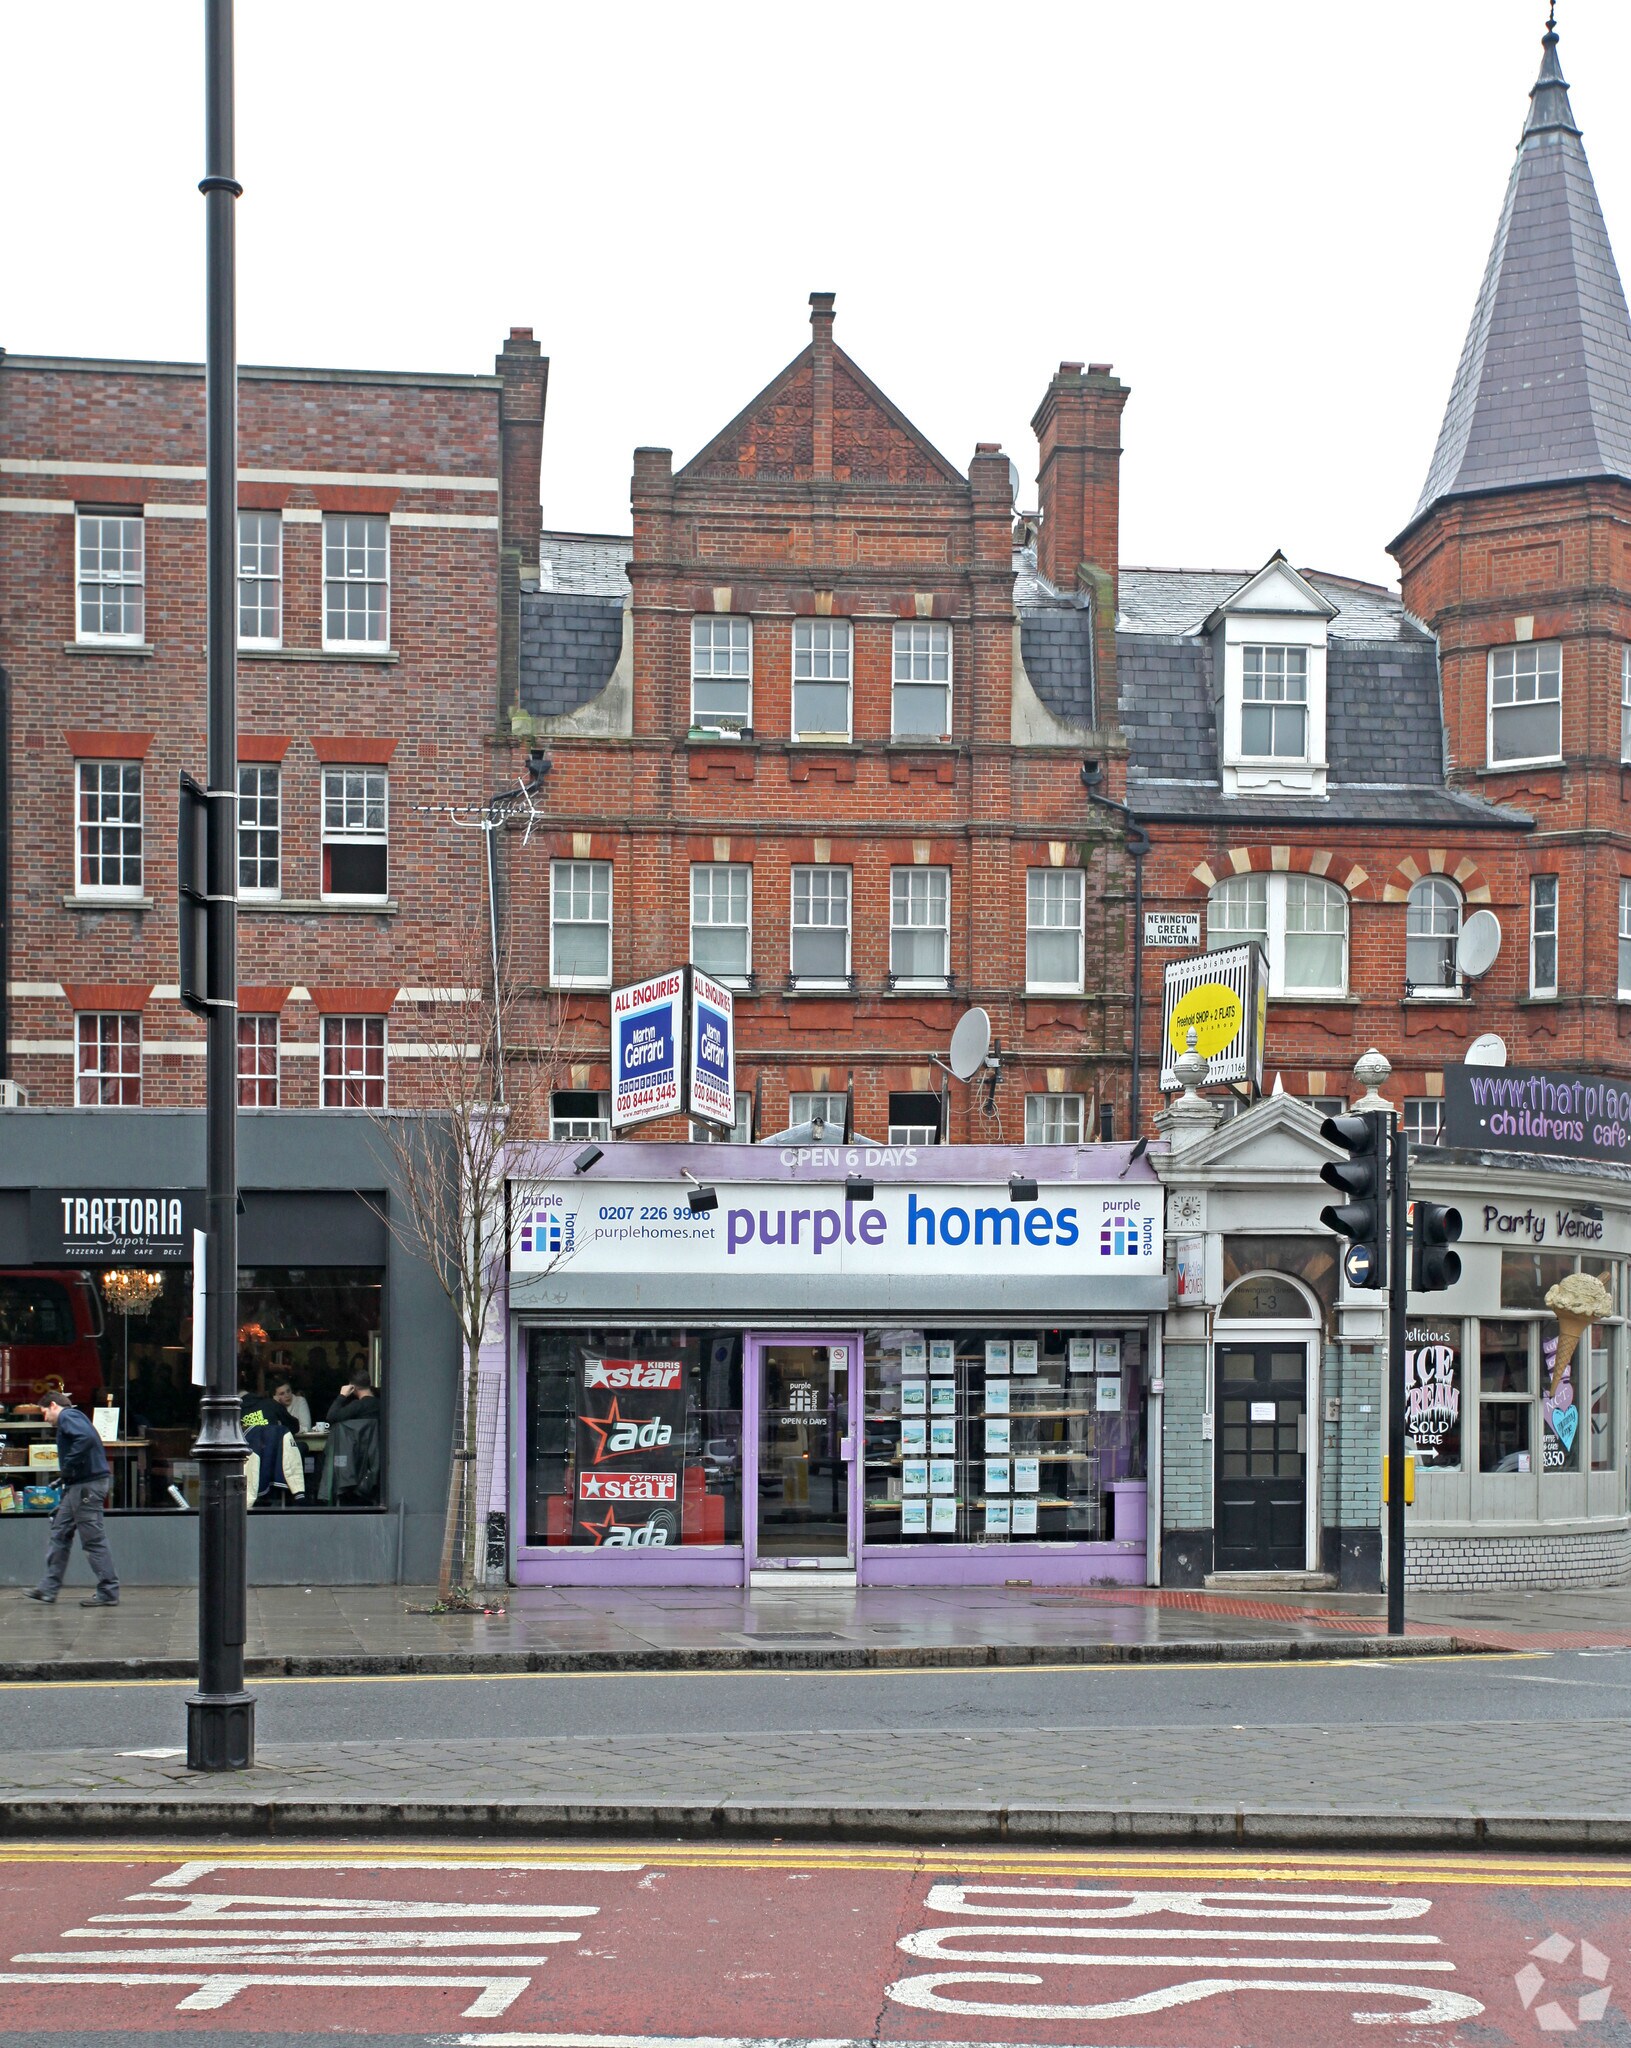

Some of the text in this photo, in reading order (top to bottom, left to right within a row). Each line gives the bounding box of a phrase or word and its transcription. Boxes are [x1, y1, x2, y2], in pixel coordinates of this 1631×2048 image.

[1147, 914, 1198, 924] NEWINGTON
[1157, 925, 1188, 934] GREEN
[615, 975, 680, 1013] ALL ENQUIRIES
[694, 976, 731, 1013] ALL ENQUIRIES
[1176, 1012, 1195, 1028] Freehold
[1195, 1010, 1209, 1024] SHOP
[1214, 1009, 1219, 1020] 2
[1218, 1005, 1236, 1019] FLATS
[632, 1026, 656, 1044] Martyn
[625, 1037, 664, 1069] Gerrard
[701, 1033, 725, 1068] Gerrard
[1210, 1066, 1226, 1076] 1177
[1231, 1063, 1246, 1074] 1166
[617, 1083, 677, 1111] 020 8444 3445
[1470, 1075, 1631, 1122] www.thatplac
[1490, 1110, 1626, 1148] children's cafe
[780, 1149, 917, 1167] OPEN 6 DAYS
[523, 1194, 563, 1208] purple
[1102, 1199, 1141, 1213] purple
[61, 1198, 182, 1235] TRATTORIA
[599, 1207, 711, 1221] 0207 226 9966
[727, 1193, 1079, 1255] purple homes
[1484, 1205, 1545, 1242] Party
[97, 1216, 150, 1248] Sapori
[565, 1213, 577, 1252] homes
[595, 1226, 716, 1241] purplehomes.net
[1142, 1217, 1155, 1256] homes
[163, 1248, 182, 1256] DELI
[1252, 1295, 1278, 1310] 1-3
[609, 1363, 680, 1388] star
[647, 1361, 681, 1369] KIBRIS
[1405, 1345, 1454, 1386] ICE
[789, 1382, 812, 1390] purple
[811, 1390, 819, 1412] homes
[781, 1417, 801, 1425] OPEN
[809, 1418, 827, 1426] DAYS
[1408, 1421, 1449, 1434] SOLD
[611, 1416, 672, 1452] ada
[1413, 1434, 1443, 1444] HERE
[604, 1477, 675, 1498] star
[629, 1474, 674, 1482] CYPRUS
[603, 1520, 668, 1546] ada
